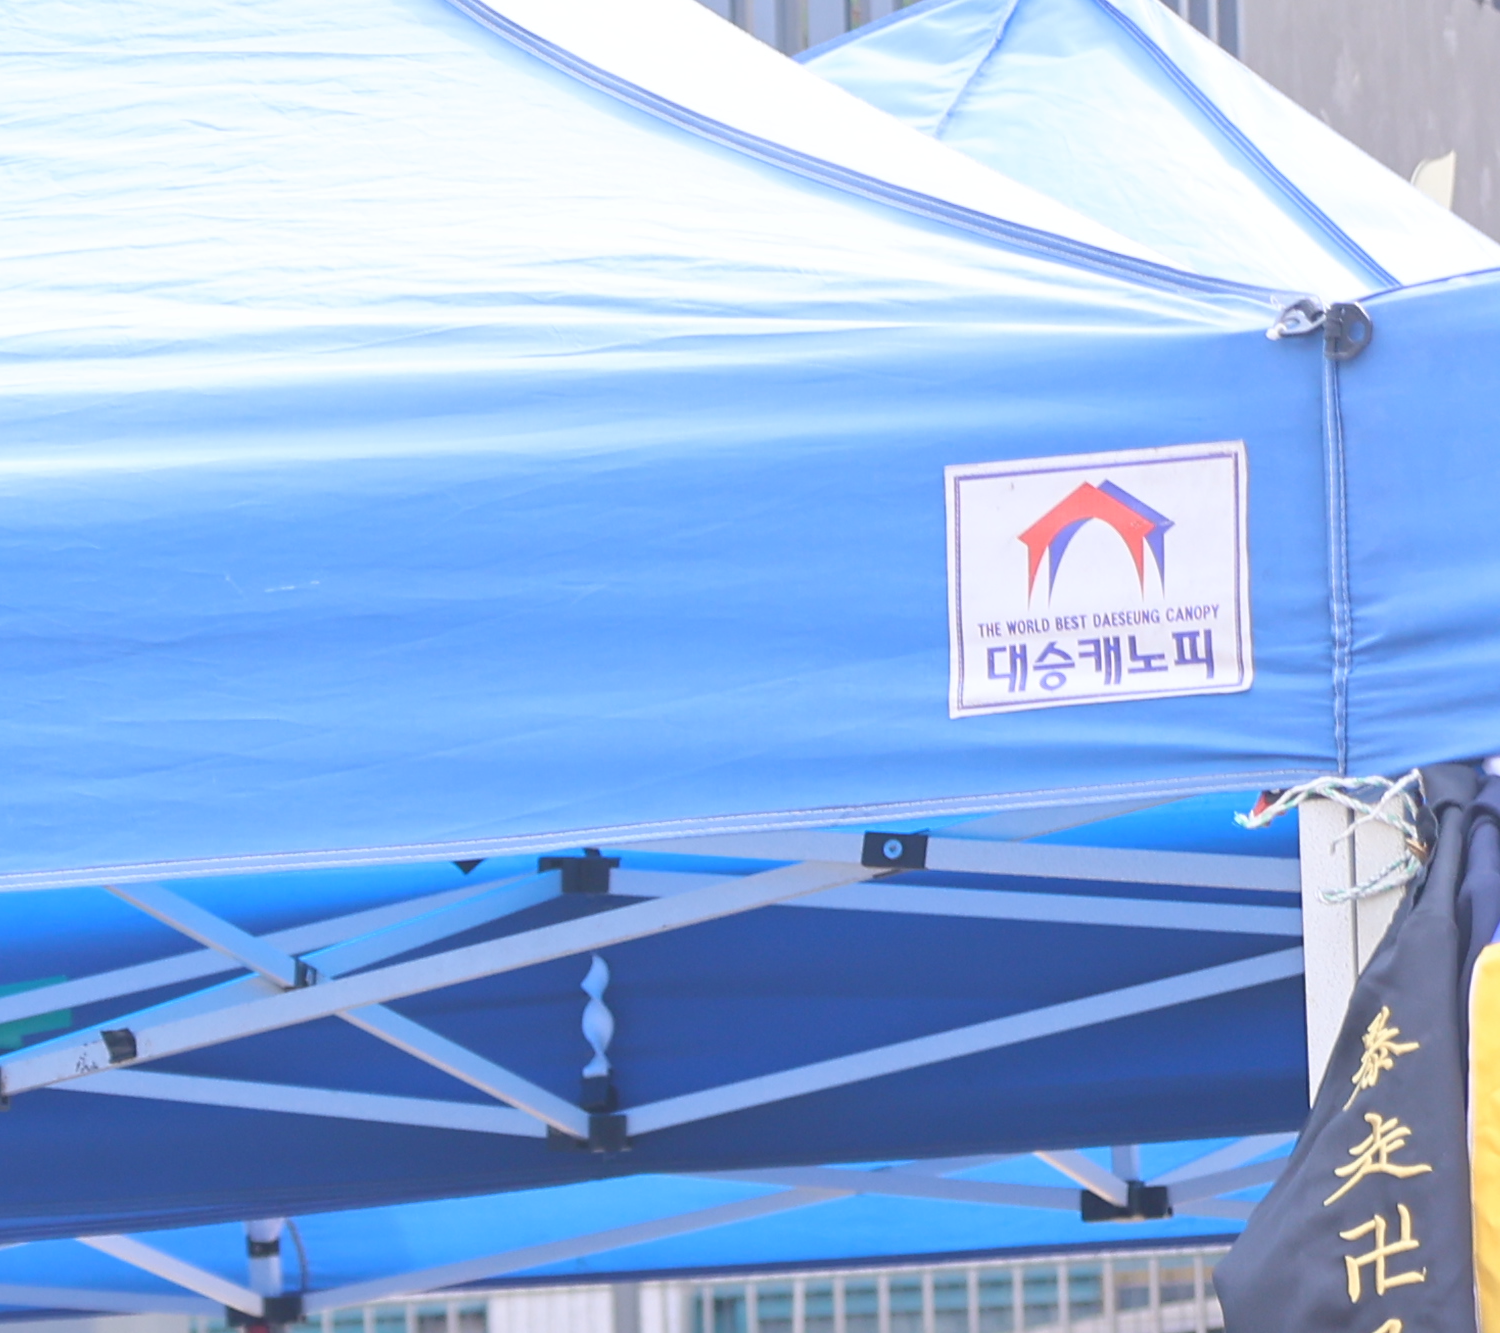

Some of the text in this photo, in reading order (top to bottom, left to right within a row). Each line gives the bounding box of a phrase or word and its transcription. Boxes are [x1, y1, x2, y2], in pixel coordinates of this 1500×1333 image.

[978, 604, 1220, 639] THE WORLD BEST DAESEUNG CANOPY
[987, 628, 1215, 693] 대승캐노피
